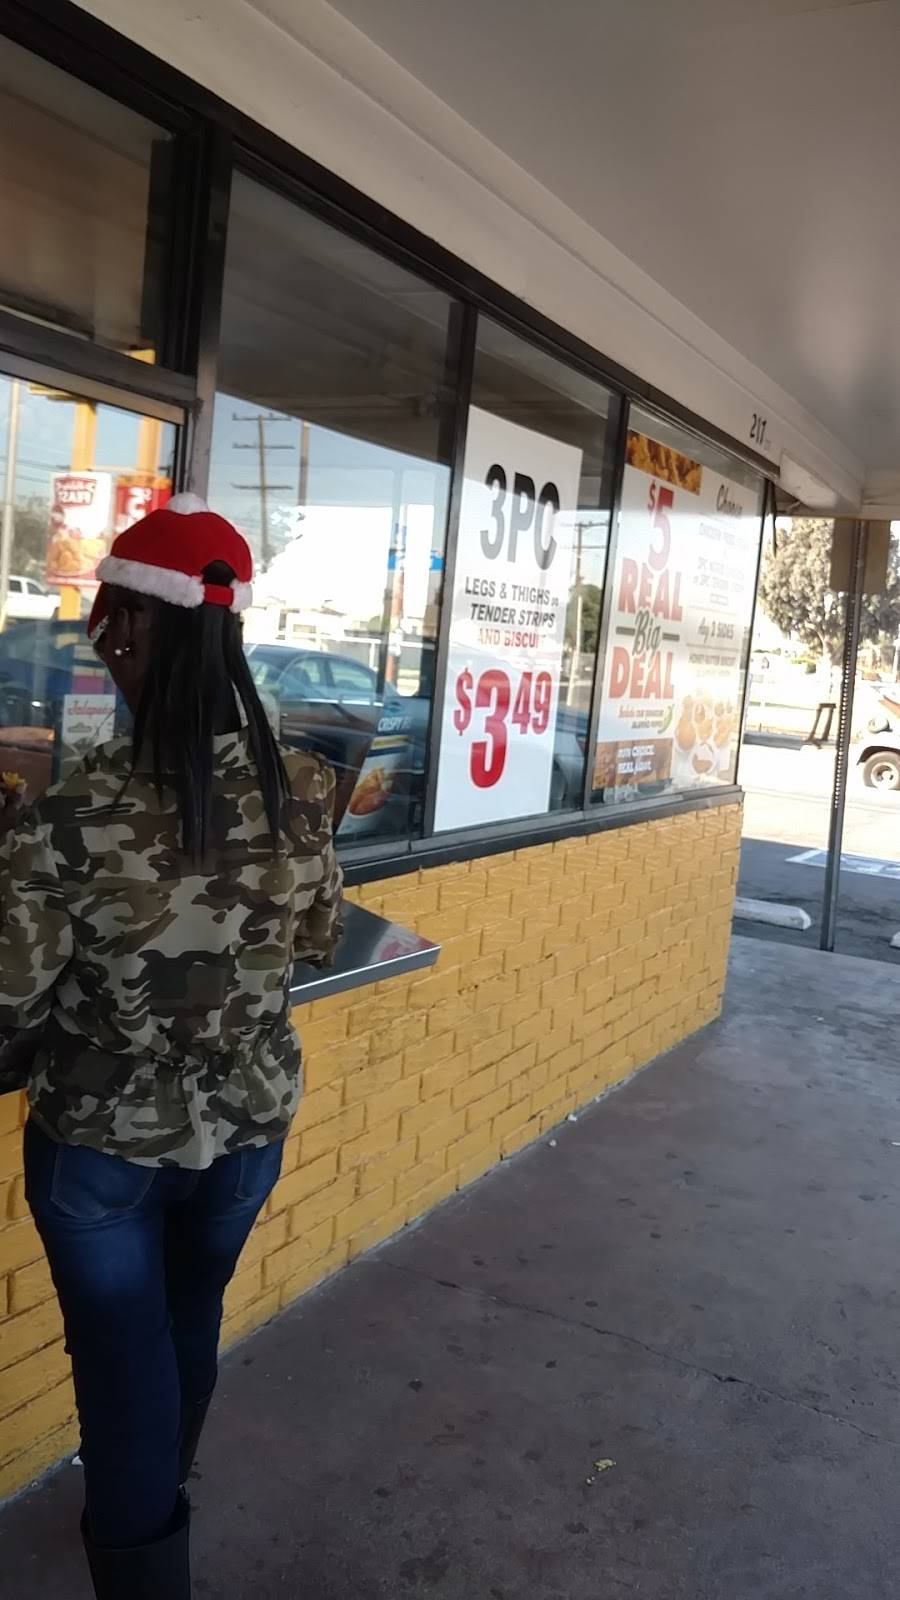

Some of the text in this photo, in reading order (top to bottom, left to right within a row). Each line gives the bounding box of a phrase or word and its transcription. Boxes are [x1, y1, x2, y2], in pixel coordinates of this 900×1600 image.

[750, 413, 767, 445] 217
[480, 463, 560, 571] 3PC
[648, 479, 674, 571] $5
[465, 576, 496, 598] LEGS
[500, 583, 507, 600] &
[511, 584, 550, 606] THIGHS
[470, 602, 556, 629] TENDER STRIPS
[617, 557, 683, 622] REAL
[479, 628, 500, 646] AND
[632, 609, 661, 668] Big
[608, 646, 675, 699] DEAL
